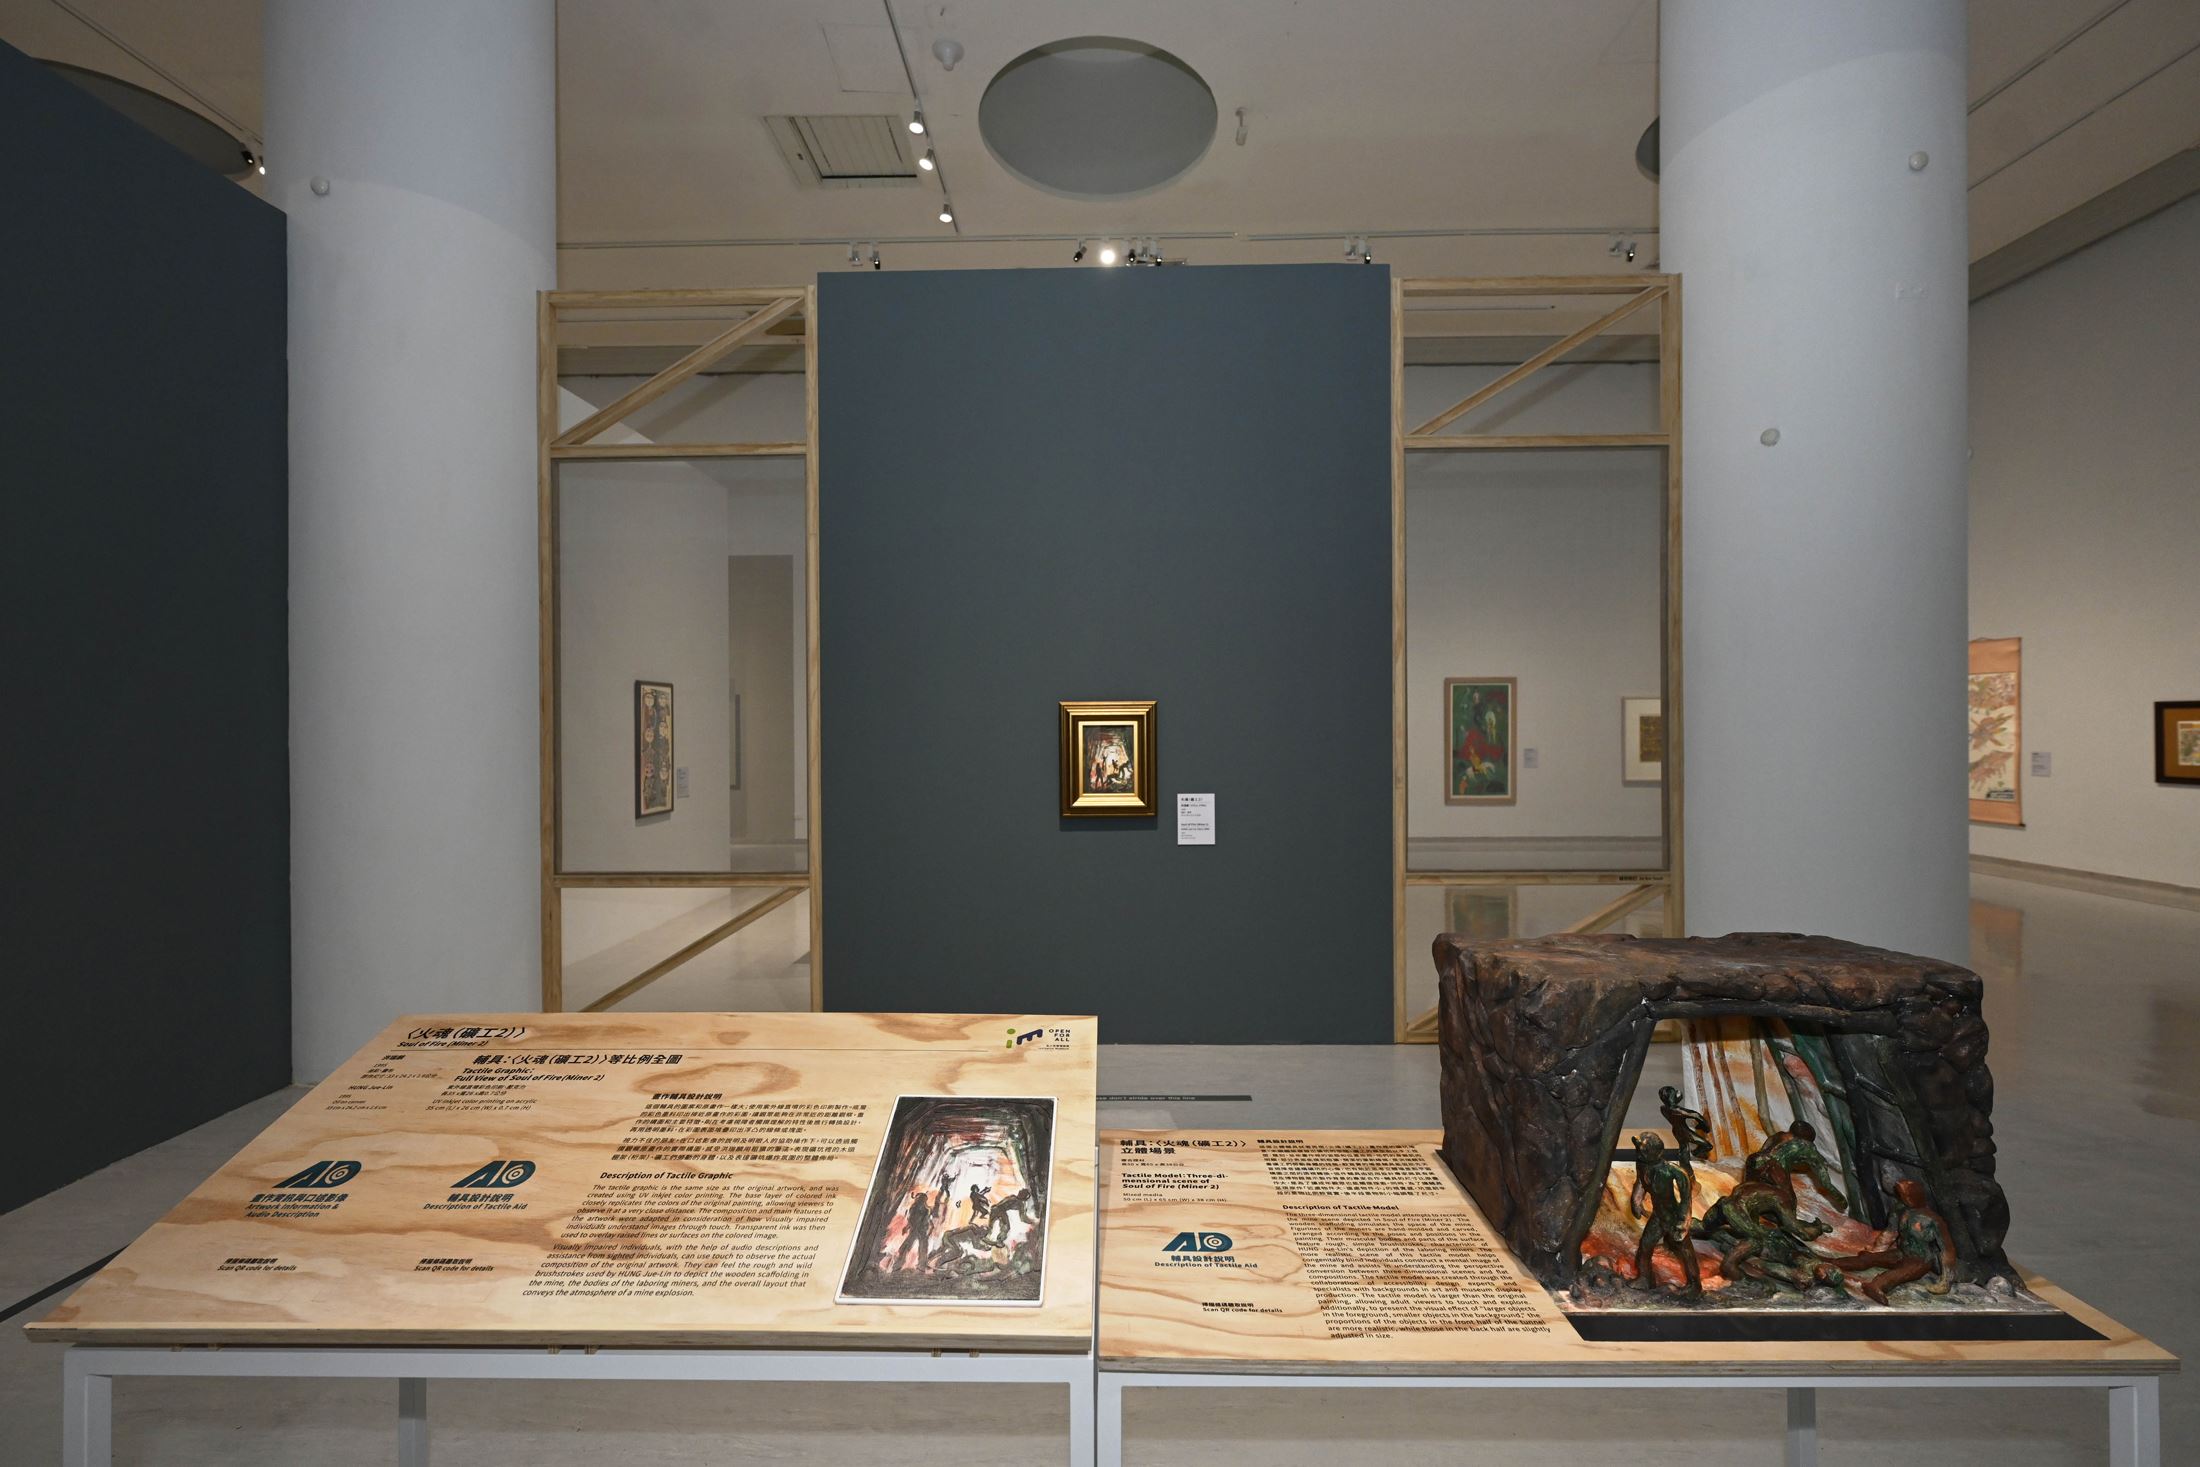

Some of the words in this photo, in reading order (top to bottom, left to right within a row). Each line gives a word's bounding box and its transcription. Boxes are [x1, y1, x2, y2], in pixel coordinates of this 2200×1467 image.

[600, 1172, 653, 1180] Description
[695, 1172, 733, 1180] Graphic
[542, 1280, 565, 1288] mine,
[634, 1280, 670, 1288] laboring
[668, 1280, 700, 1288] miners,
[761, 1281, 788, 1289] layout
[567, 1289, 617, 1297] atmosphere
[653, 1289, 694, 1298] explosion.
